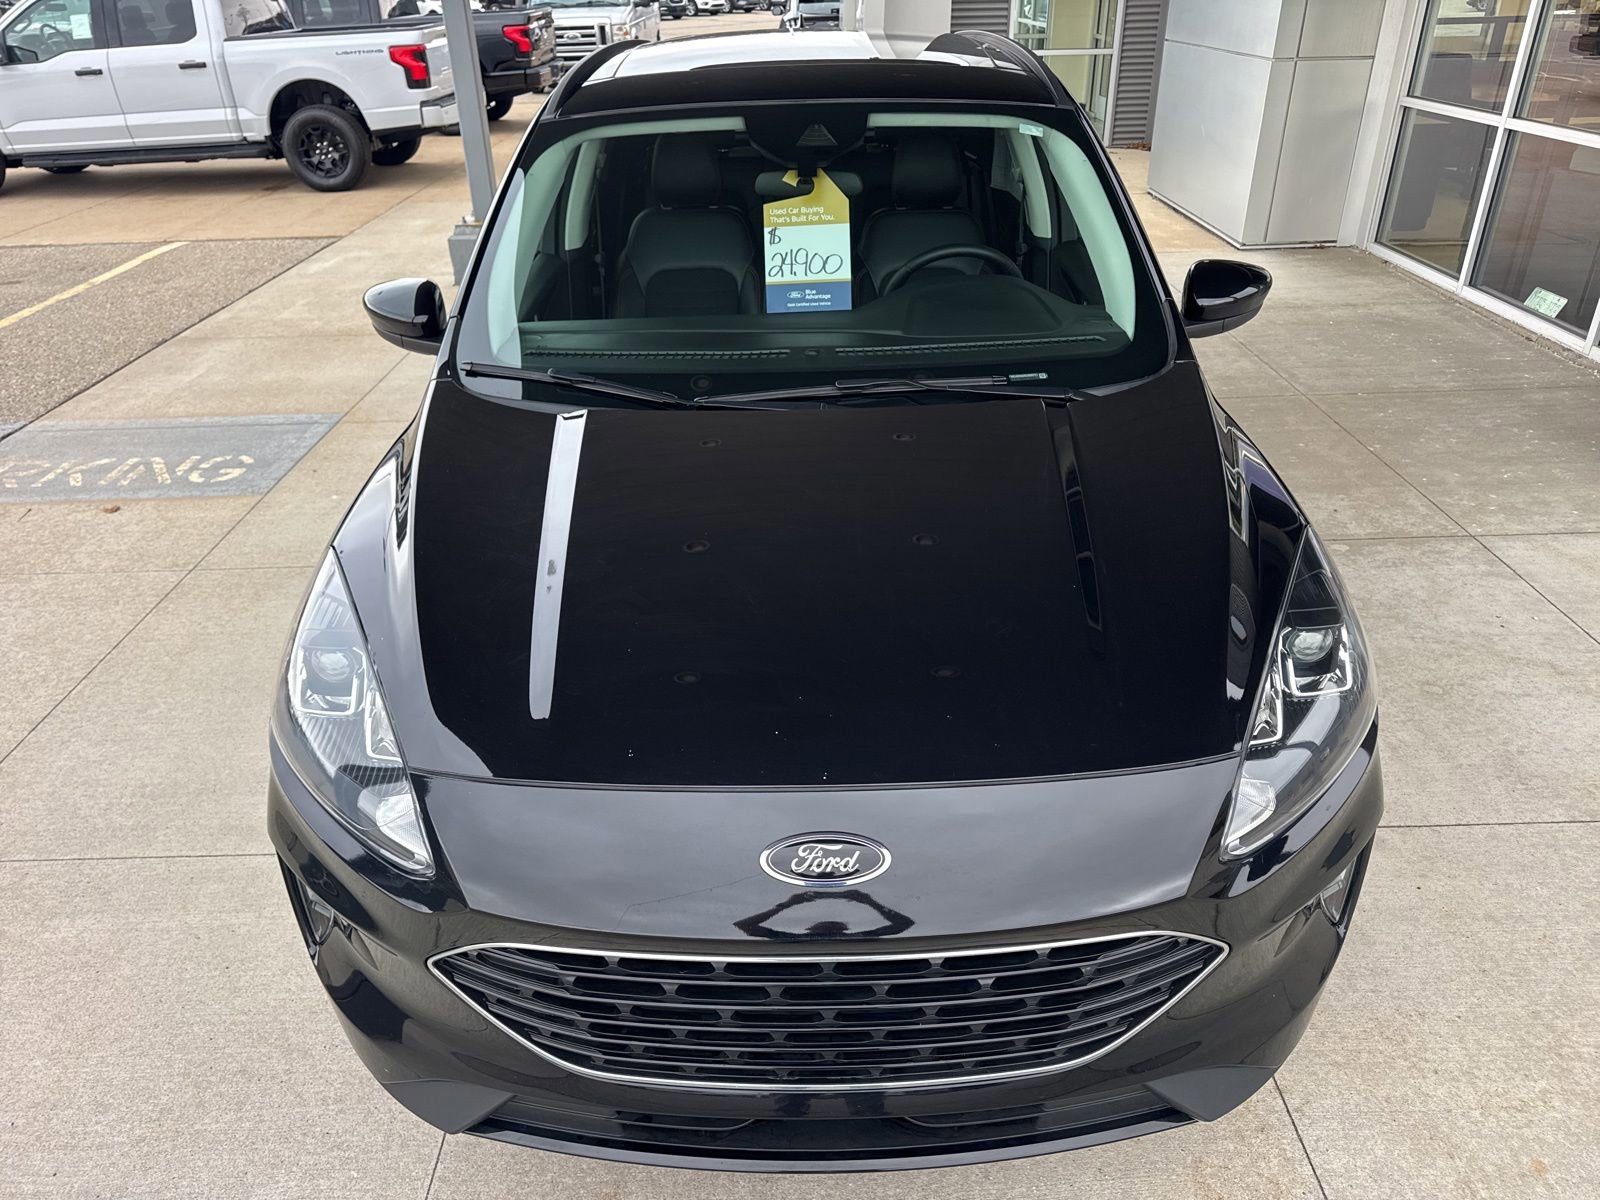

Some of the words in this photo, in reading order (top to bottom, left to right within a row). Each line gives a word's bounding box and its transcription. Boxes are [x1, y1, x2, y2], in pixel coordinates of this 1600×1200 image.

[769, 207, 787, 215] Used
[800, 206, 824, 214] Buying
[790, 843, 861, 873] Ford
